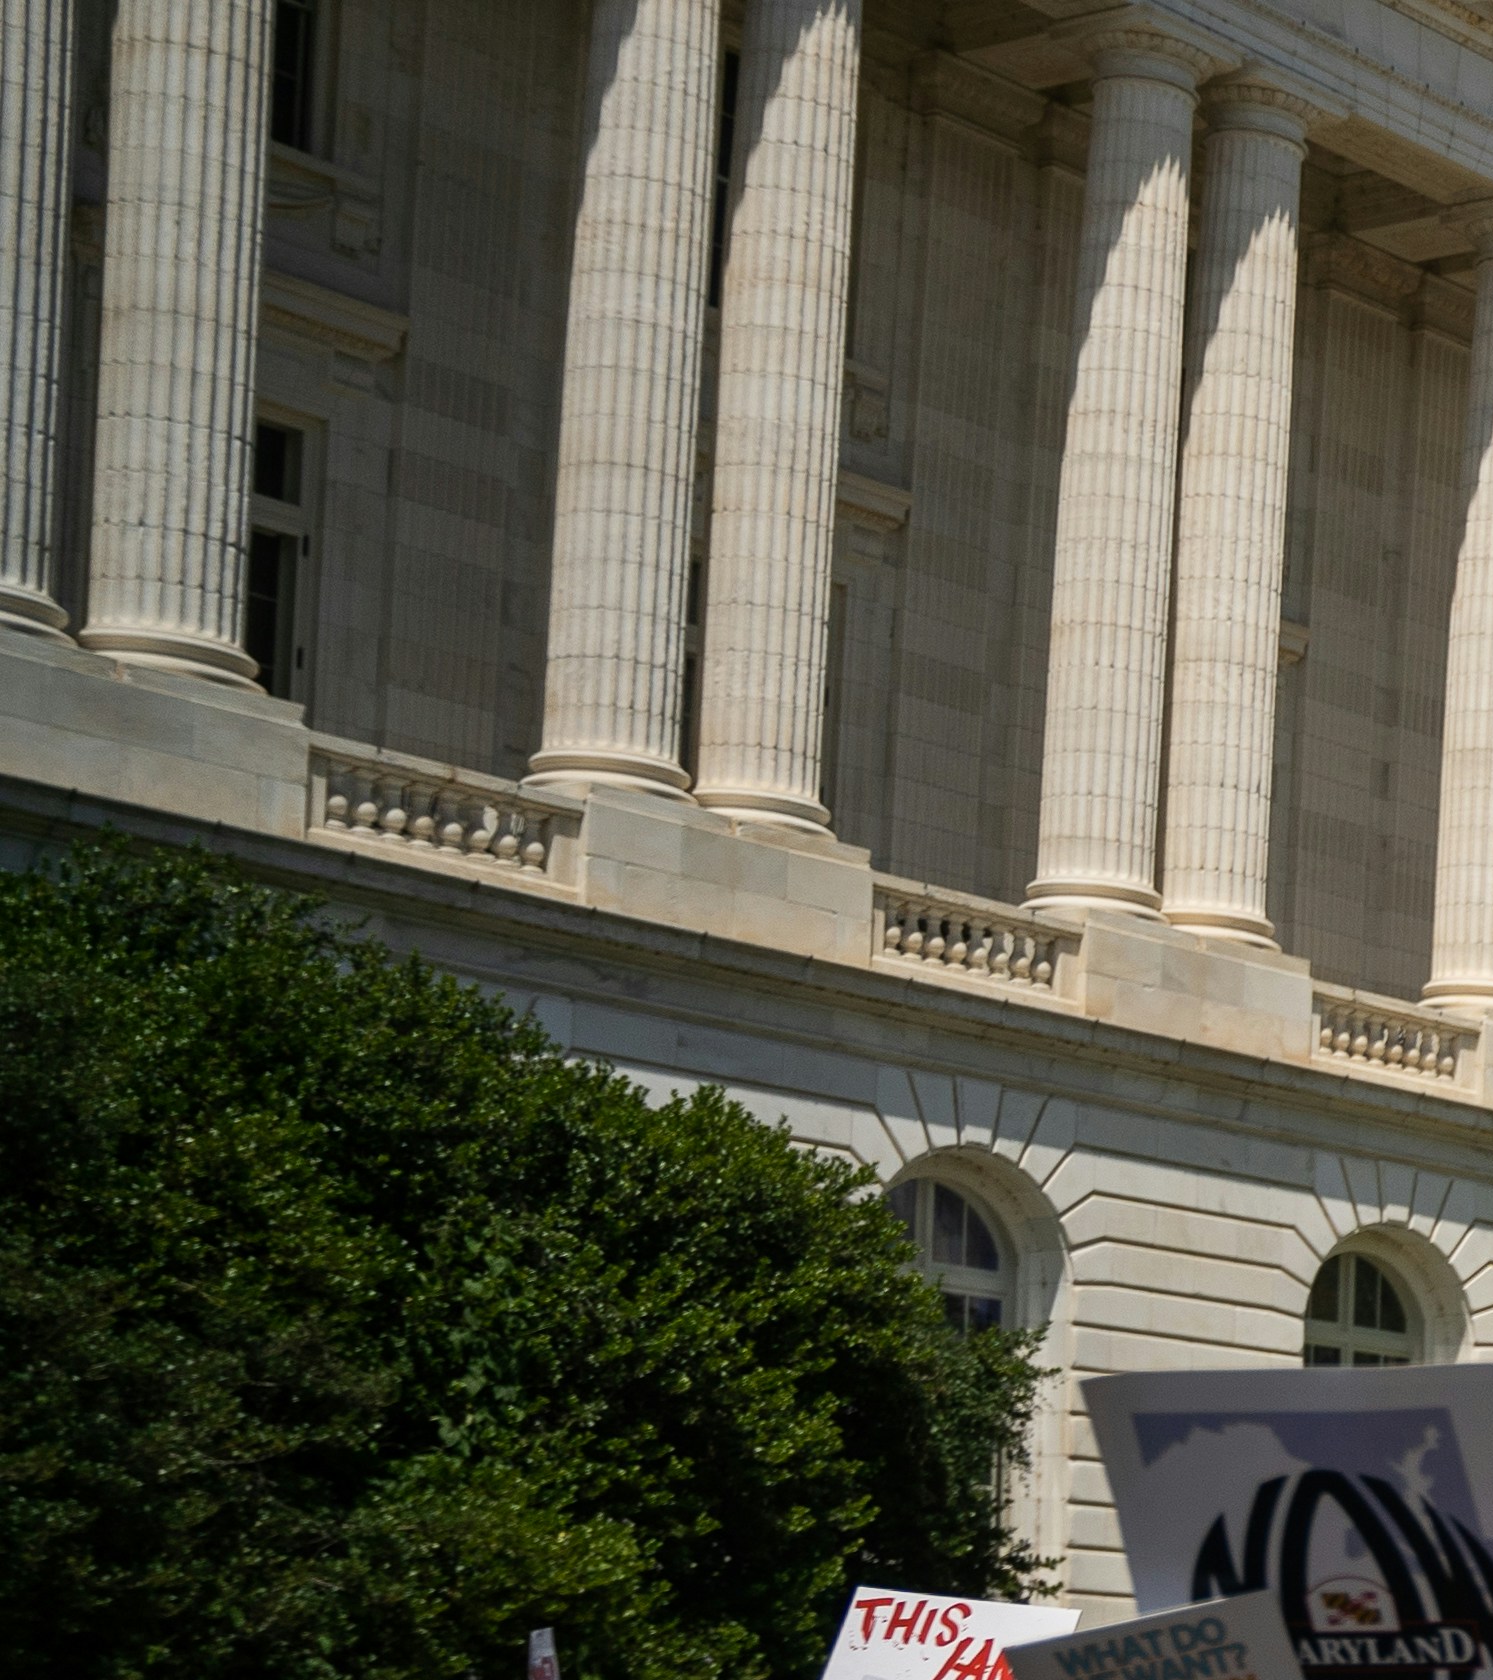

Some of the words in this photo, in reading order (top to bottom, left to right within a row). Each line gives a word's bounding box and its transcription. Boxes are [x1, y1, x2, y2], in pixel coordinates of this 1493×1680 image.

[855, 1597, 972, 1648] THIS
[1055, 1628, 1166, 1676] WHAT
[1169, 1617, 1226, 1654] DO
[1299, 1627, 1477, 1666] ARYLAND
